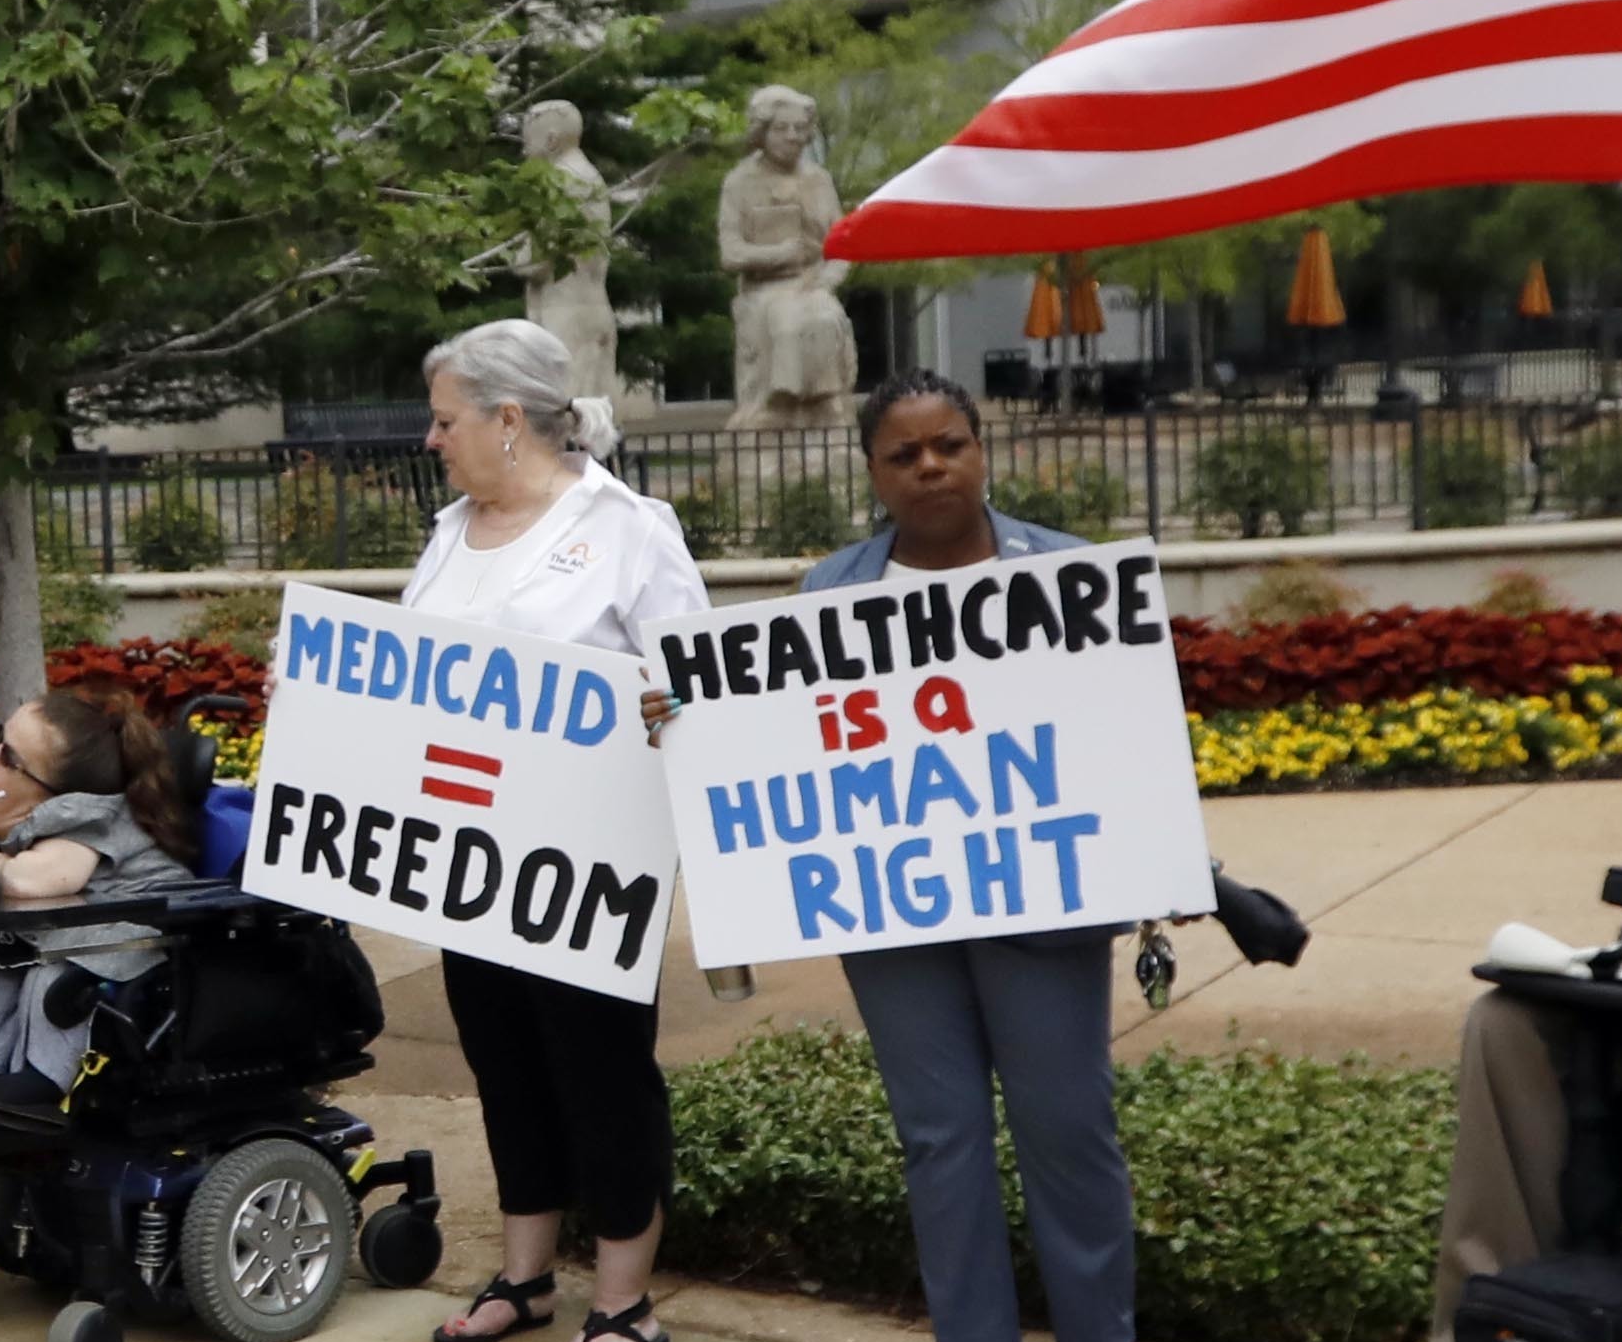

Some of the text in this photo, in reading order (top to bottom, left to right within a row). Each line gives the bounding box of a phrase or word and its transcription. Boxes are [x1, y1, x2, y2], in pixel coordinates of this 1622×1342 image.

[288, 612, 617, 747] MEDICAID
[659, 554, 1167, 705] HEALTHCARE
[815, 675, 974, 752] is a
[707, 723, 1062, 853] HUMAN
[263, 782, 660, 972] FREEDOM
[788, 812, 1101, 940] RIGHT
